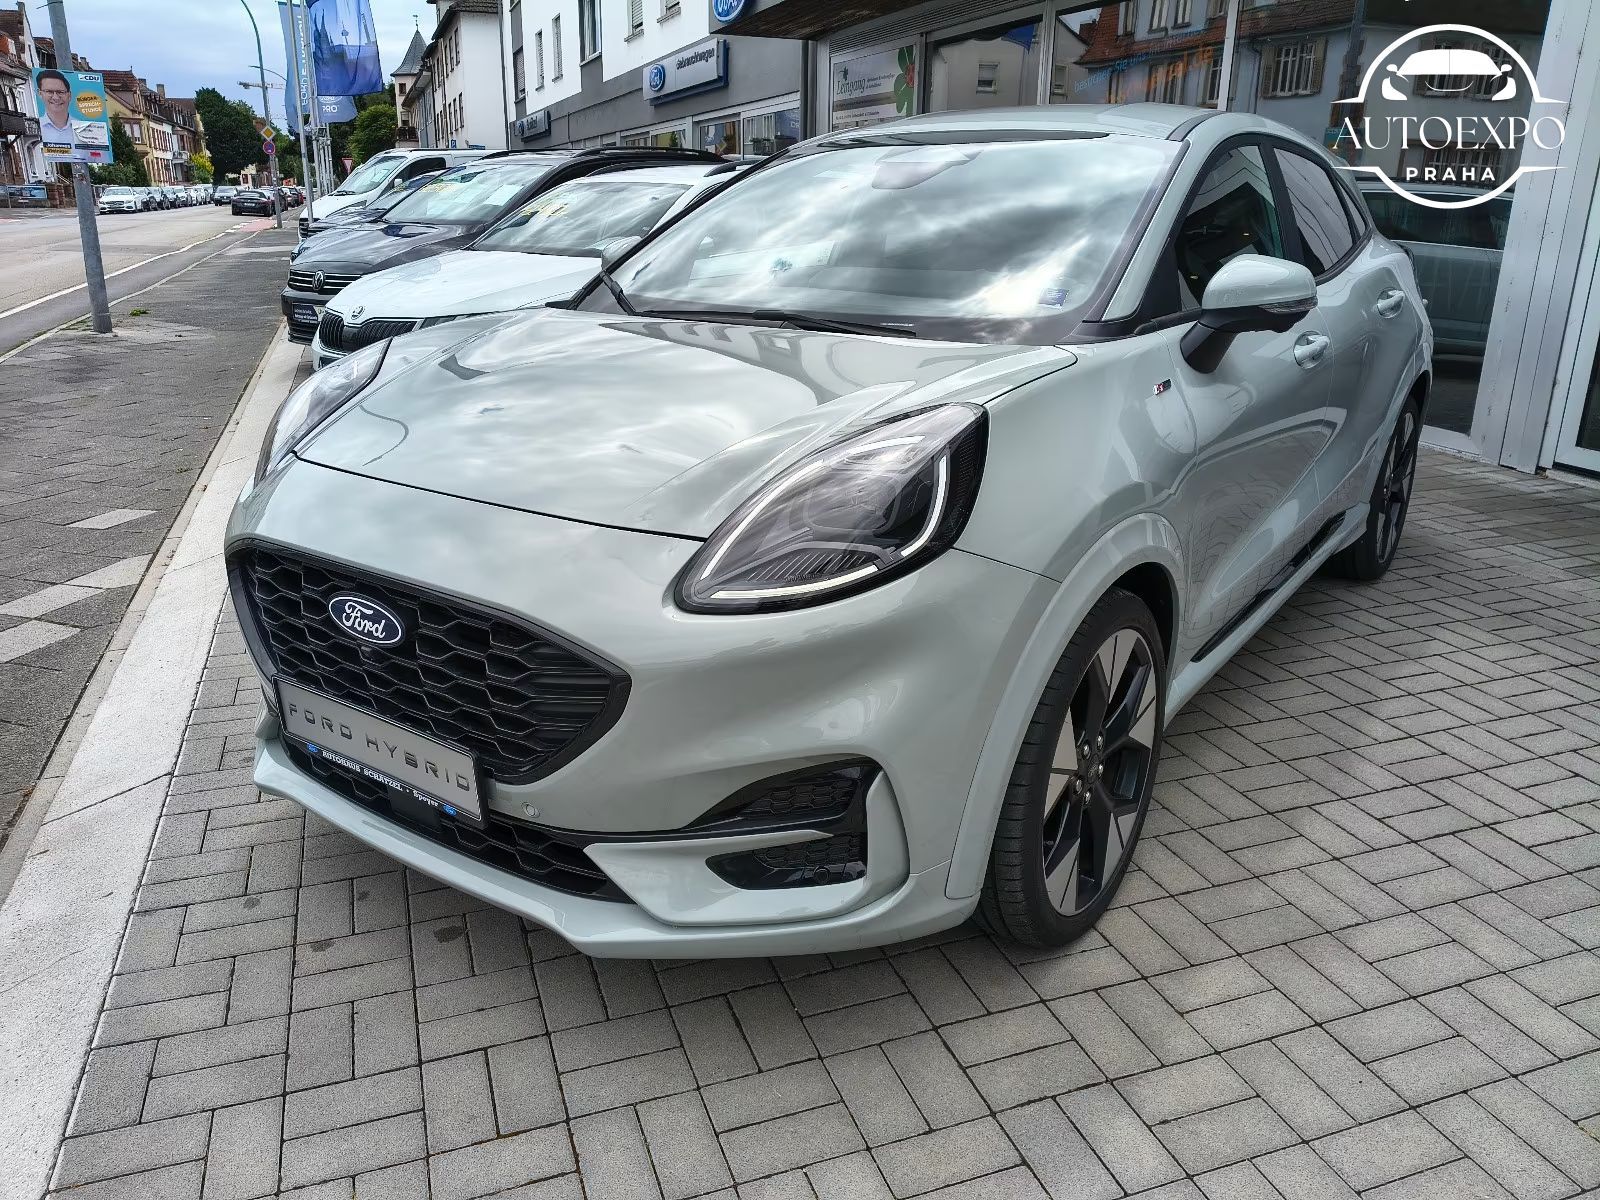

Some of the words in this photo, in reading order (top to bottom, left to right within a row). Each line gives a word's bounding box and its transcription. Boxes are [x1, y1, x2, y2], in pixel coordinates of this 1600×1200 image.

[342, 601, 386, 639] Ford
[288, 703, 353, 740] FORD
[365, 731, 470, 792] HYBRID
